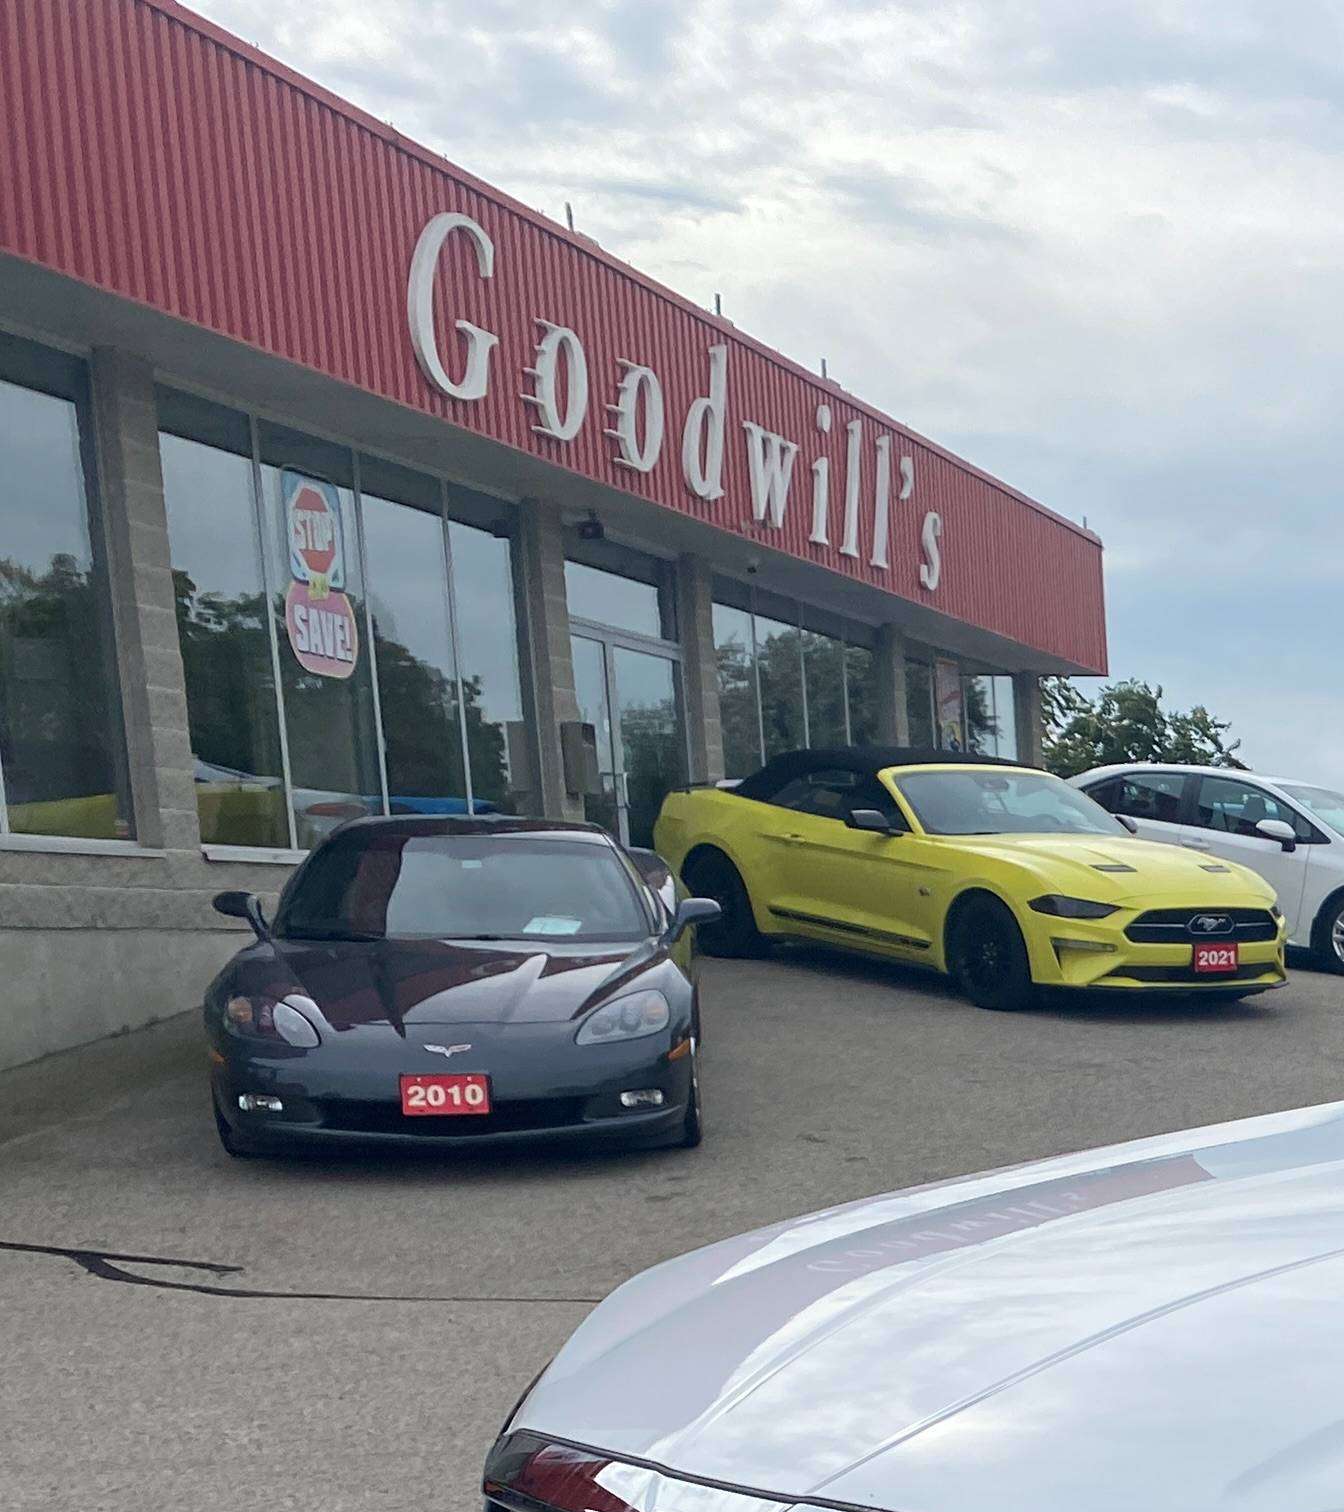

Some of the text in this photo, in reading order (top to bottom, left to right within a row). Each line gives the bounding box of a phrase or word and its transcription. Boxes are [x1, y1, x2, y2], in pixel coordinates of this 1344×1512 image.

[407, 211, 943, 591] Goodwill's
[291, 510, 335, 552] STOP
[293, 603, 353, 662] SAVE!
[1198, 950, 1236, 966] 2021
[407, 1083, 484, 1107] 2010
